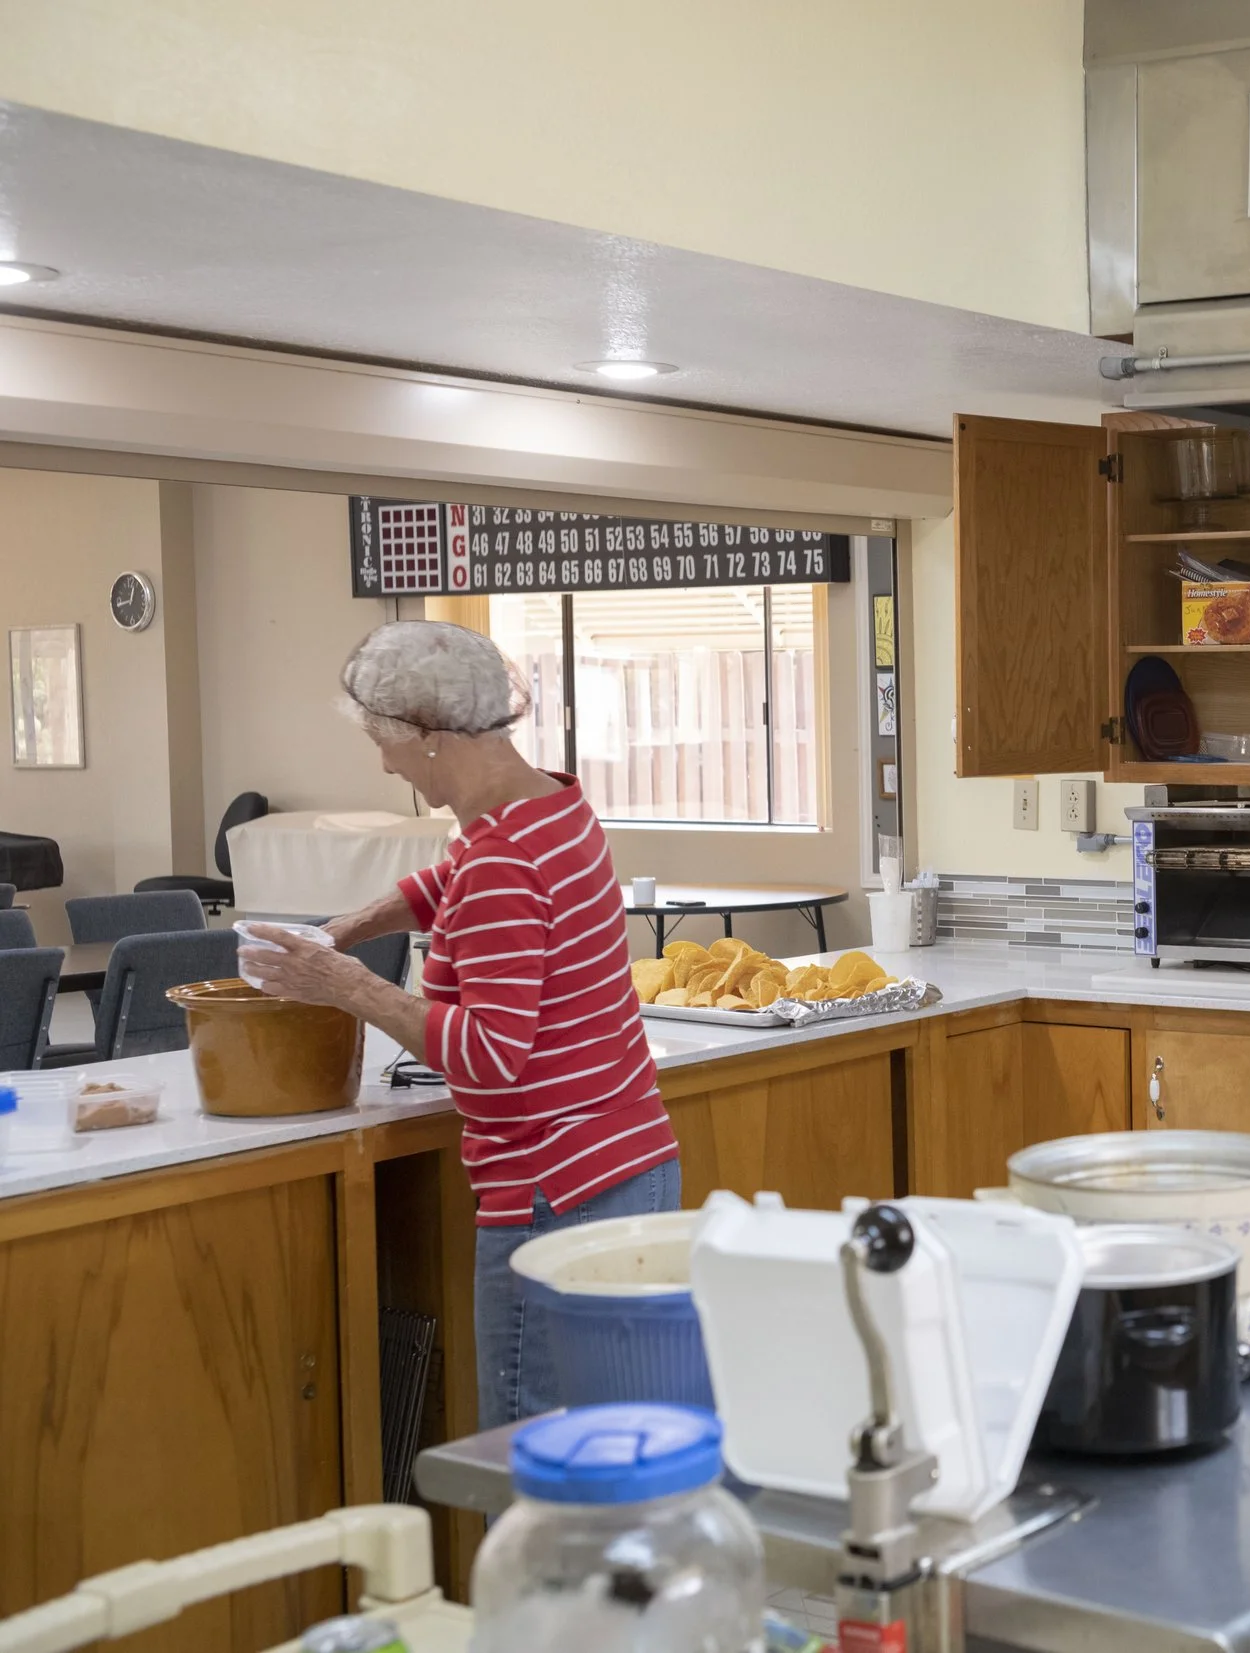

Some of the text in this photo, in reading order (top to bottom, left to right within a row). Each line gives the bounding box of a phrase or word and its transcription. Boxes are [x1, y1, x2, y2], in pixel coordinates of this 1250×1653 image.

[360, 496, 372, 568] TRONIC
[450, 505, 465, 527] N
[473, 506, 485, 525] 31
[452, 535, 466, 558] G
[472, 533, 488, 556] 46
[495, 532, 509, 554] 47
[516, 531, 532, 554] 48
[539, 530, 555, 553] 49
[561, 529, 578, 553] 50
[585, 528, 599, 552] 51
[606, 527, 623, 551] 52
[626, 526, 644, 550] 53
[651, 525, 668, 549] 54
[674, 523, 692, 547] 55
[699, 523, 718, 546] 56
[725, 525, 741, 545] 57
[452, 549, 823, 588] O 61 62 63 64 65 66 67 68 69 70 71 72 73 74 75
[1188, 588, 1227, 598] Homestyle
